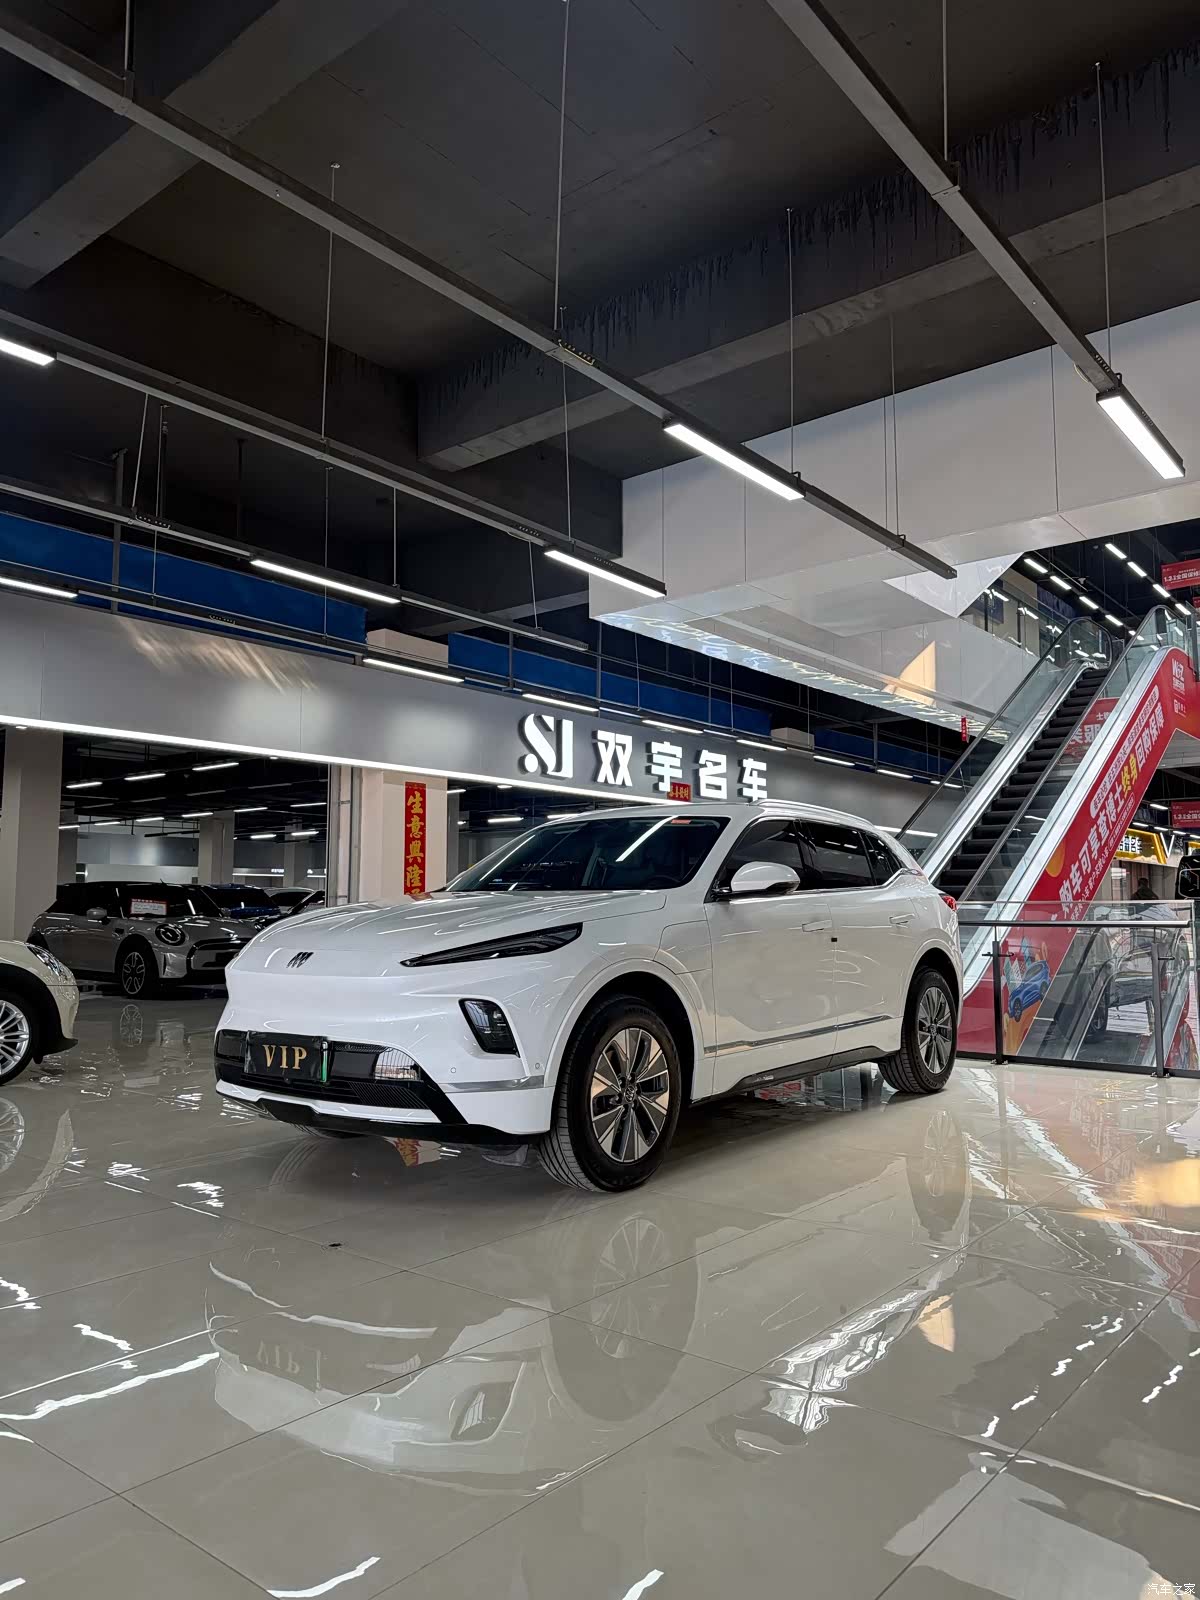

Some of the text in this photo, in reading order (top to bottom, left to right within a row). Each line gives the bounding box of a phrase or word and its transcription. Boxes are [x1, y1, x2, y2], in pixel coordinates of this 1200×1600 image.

[596, 729, 768, 801] 双宇名车
[1059, 702, 1164, 919] 购车可享查博士终身回购保障
[262, 1044, 308, 1070] VIP
